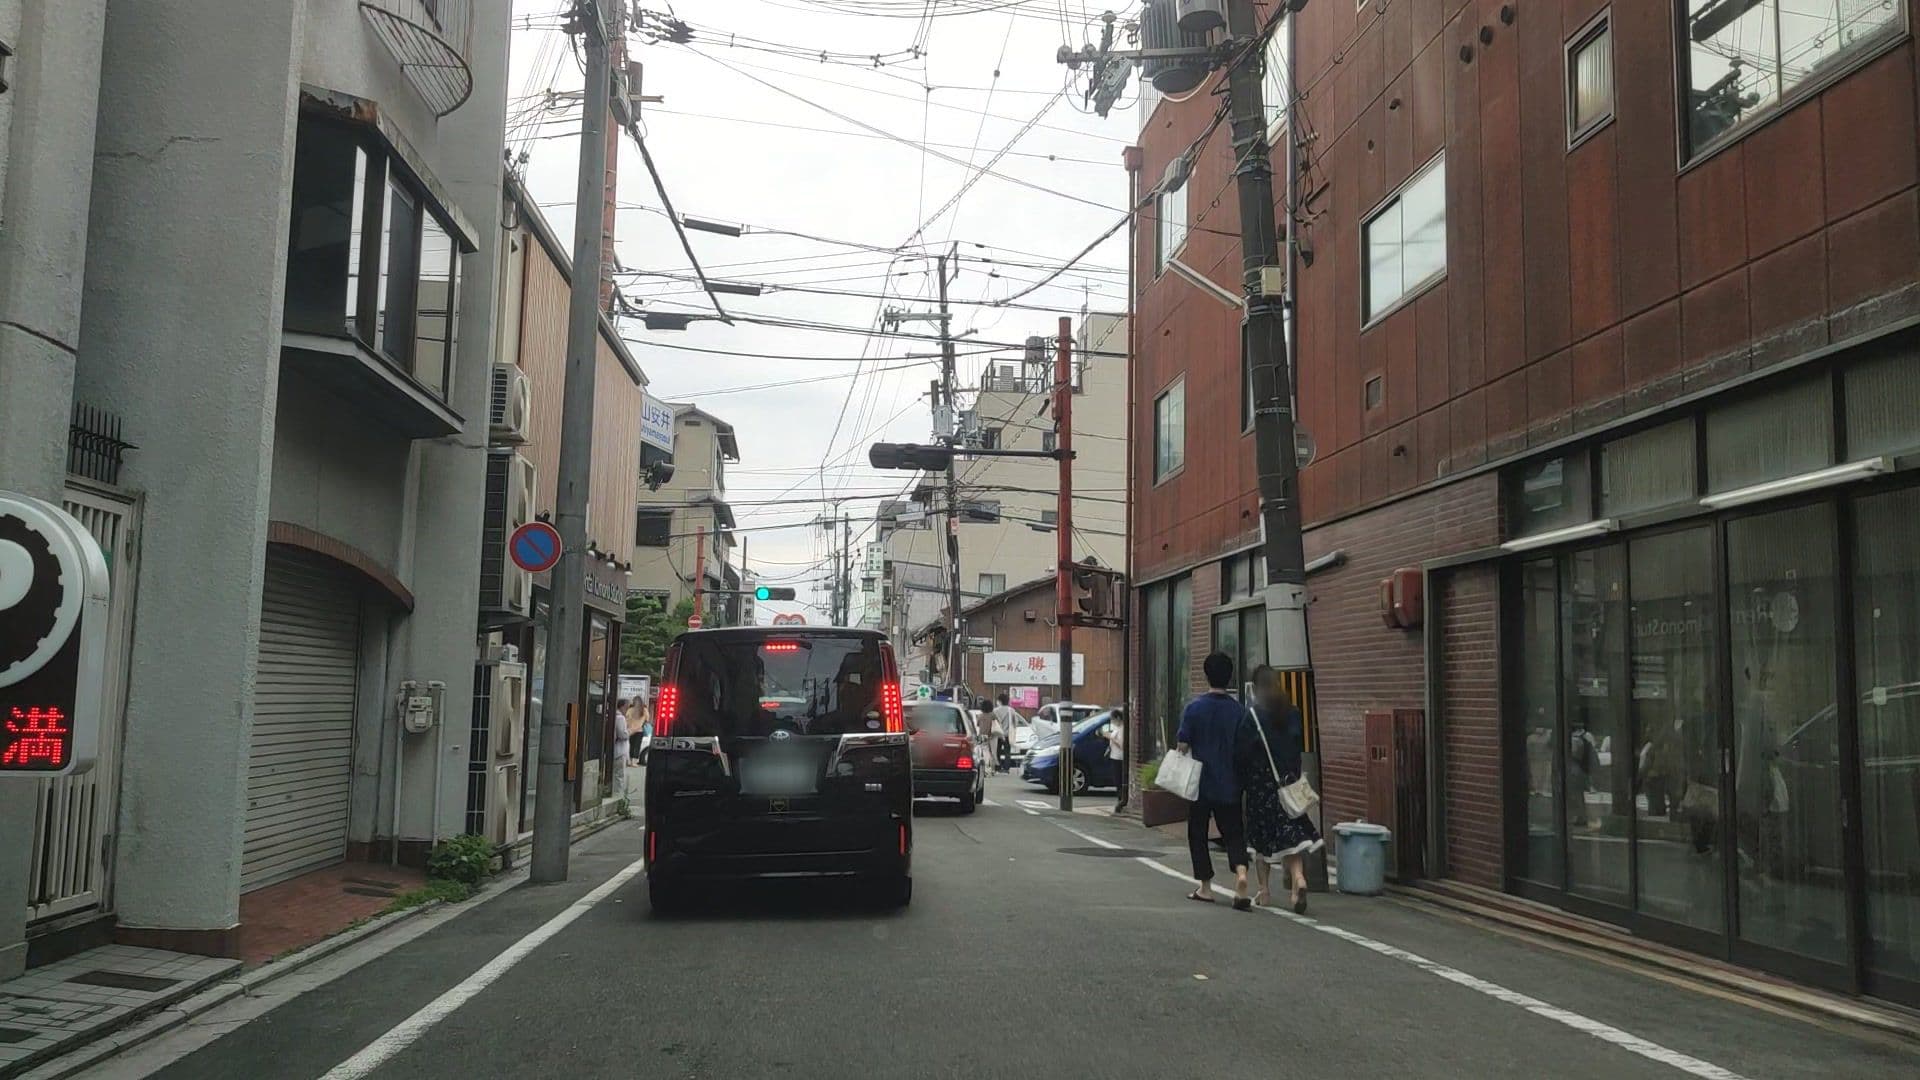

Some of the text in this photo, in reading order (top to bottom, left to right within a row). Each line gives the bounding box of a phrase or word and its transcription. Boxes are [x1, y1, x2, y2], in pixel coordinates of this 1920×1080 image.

[992, 656, 1047, 673] らーめん 勝
[3, 707, 67, 763] 満
